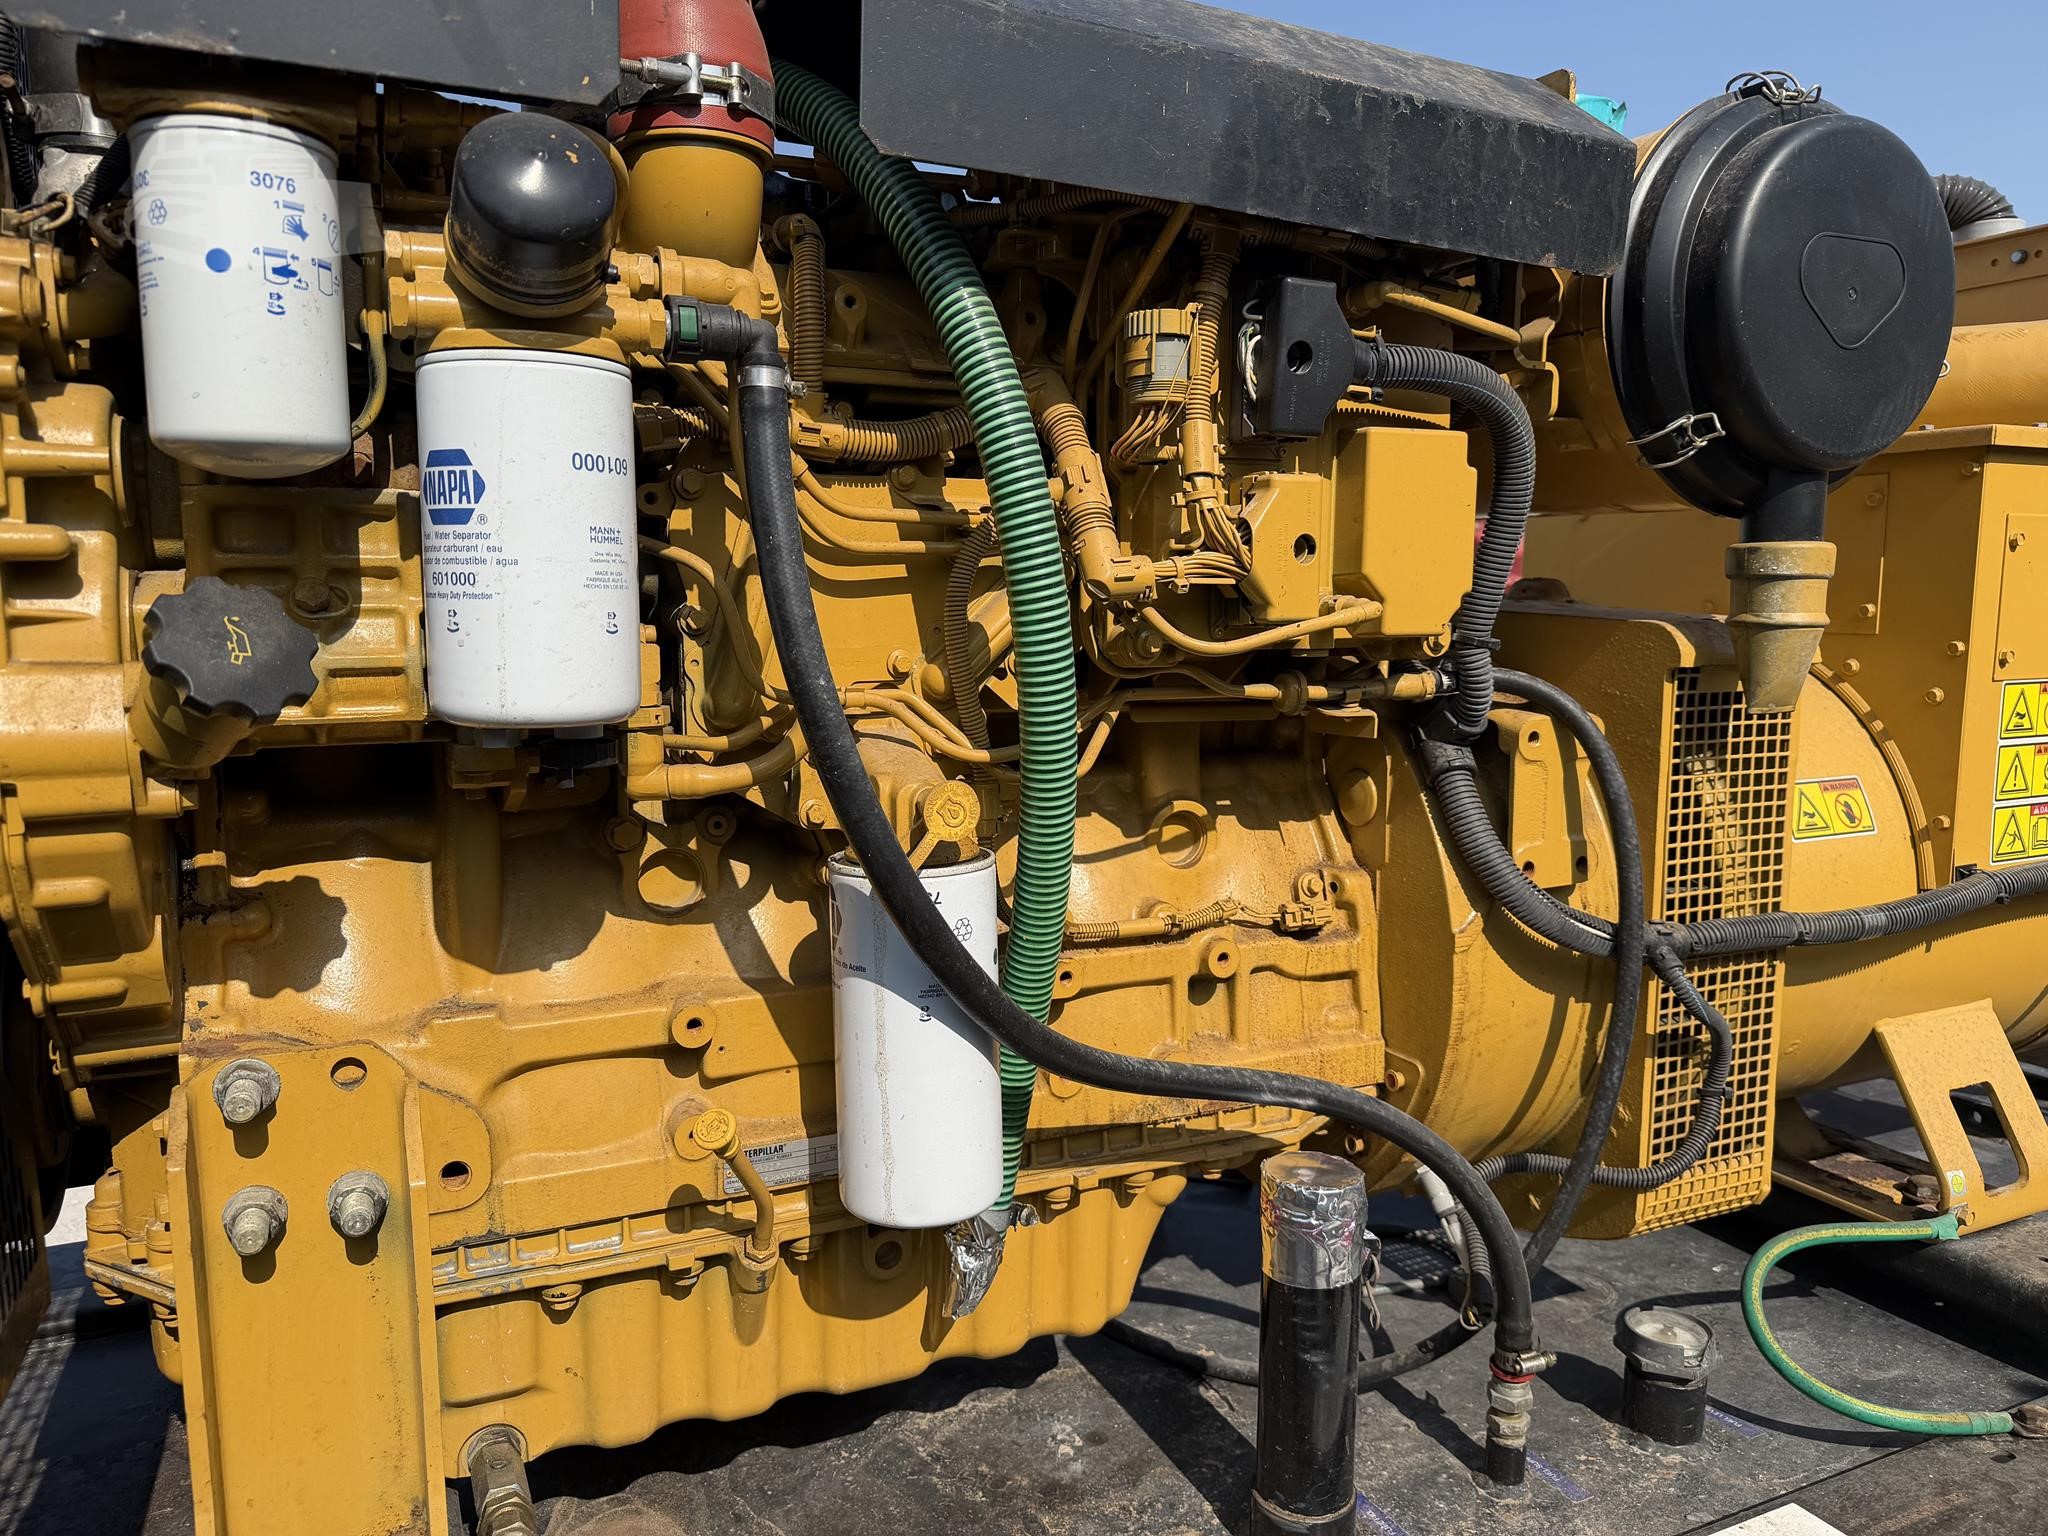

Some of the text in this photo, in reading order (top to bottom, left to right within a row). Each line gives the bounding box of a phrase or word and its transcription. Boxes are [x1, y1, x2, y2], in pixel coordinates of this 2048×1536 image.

[249, 170, 296, 194] 3076
[253, 247, 260, 255] 4
[312, 258, 316, 266] 5
[572, 452, 628, 476] 601000
[426, 469, 471, 505] NAPA
[590, 526, 620, 536] MANN+
[435, 531, 450, 540] Water
[452, 531, 491, 542] Separator
[590, 535, 623, 545] HUMMEL
[443, 543, 478, 552] carburant
[435, 556, 440, 564] de
[442, 557, 487, 565] combustible
[496, 558, 518, 567] agua
[433, 572, 476, 586] 601000
[450, 591, 461, 600] Duty
[463, 591, 492, 599] Protection
[1830, 781, 1858, 791] WARNING
[848, 963, 867, 973] Aceite
